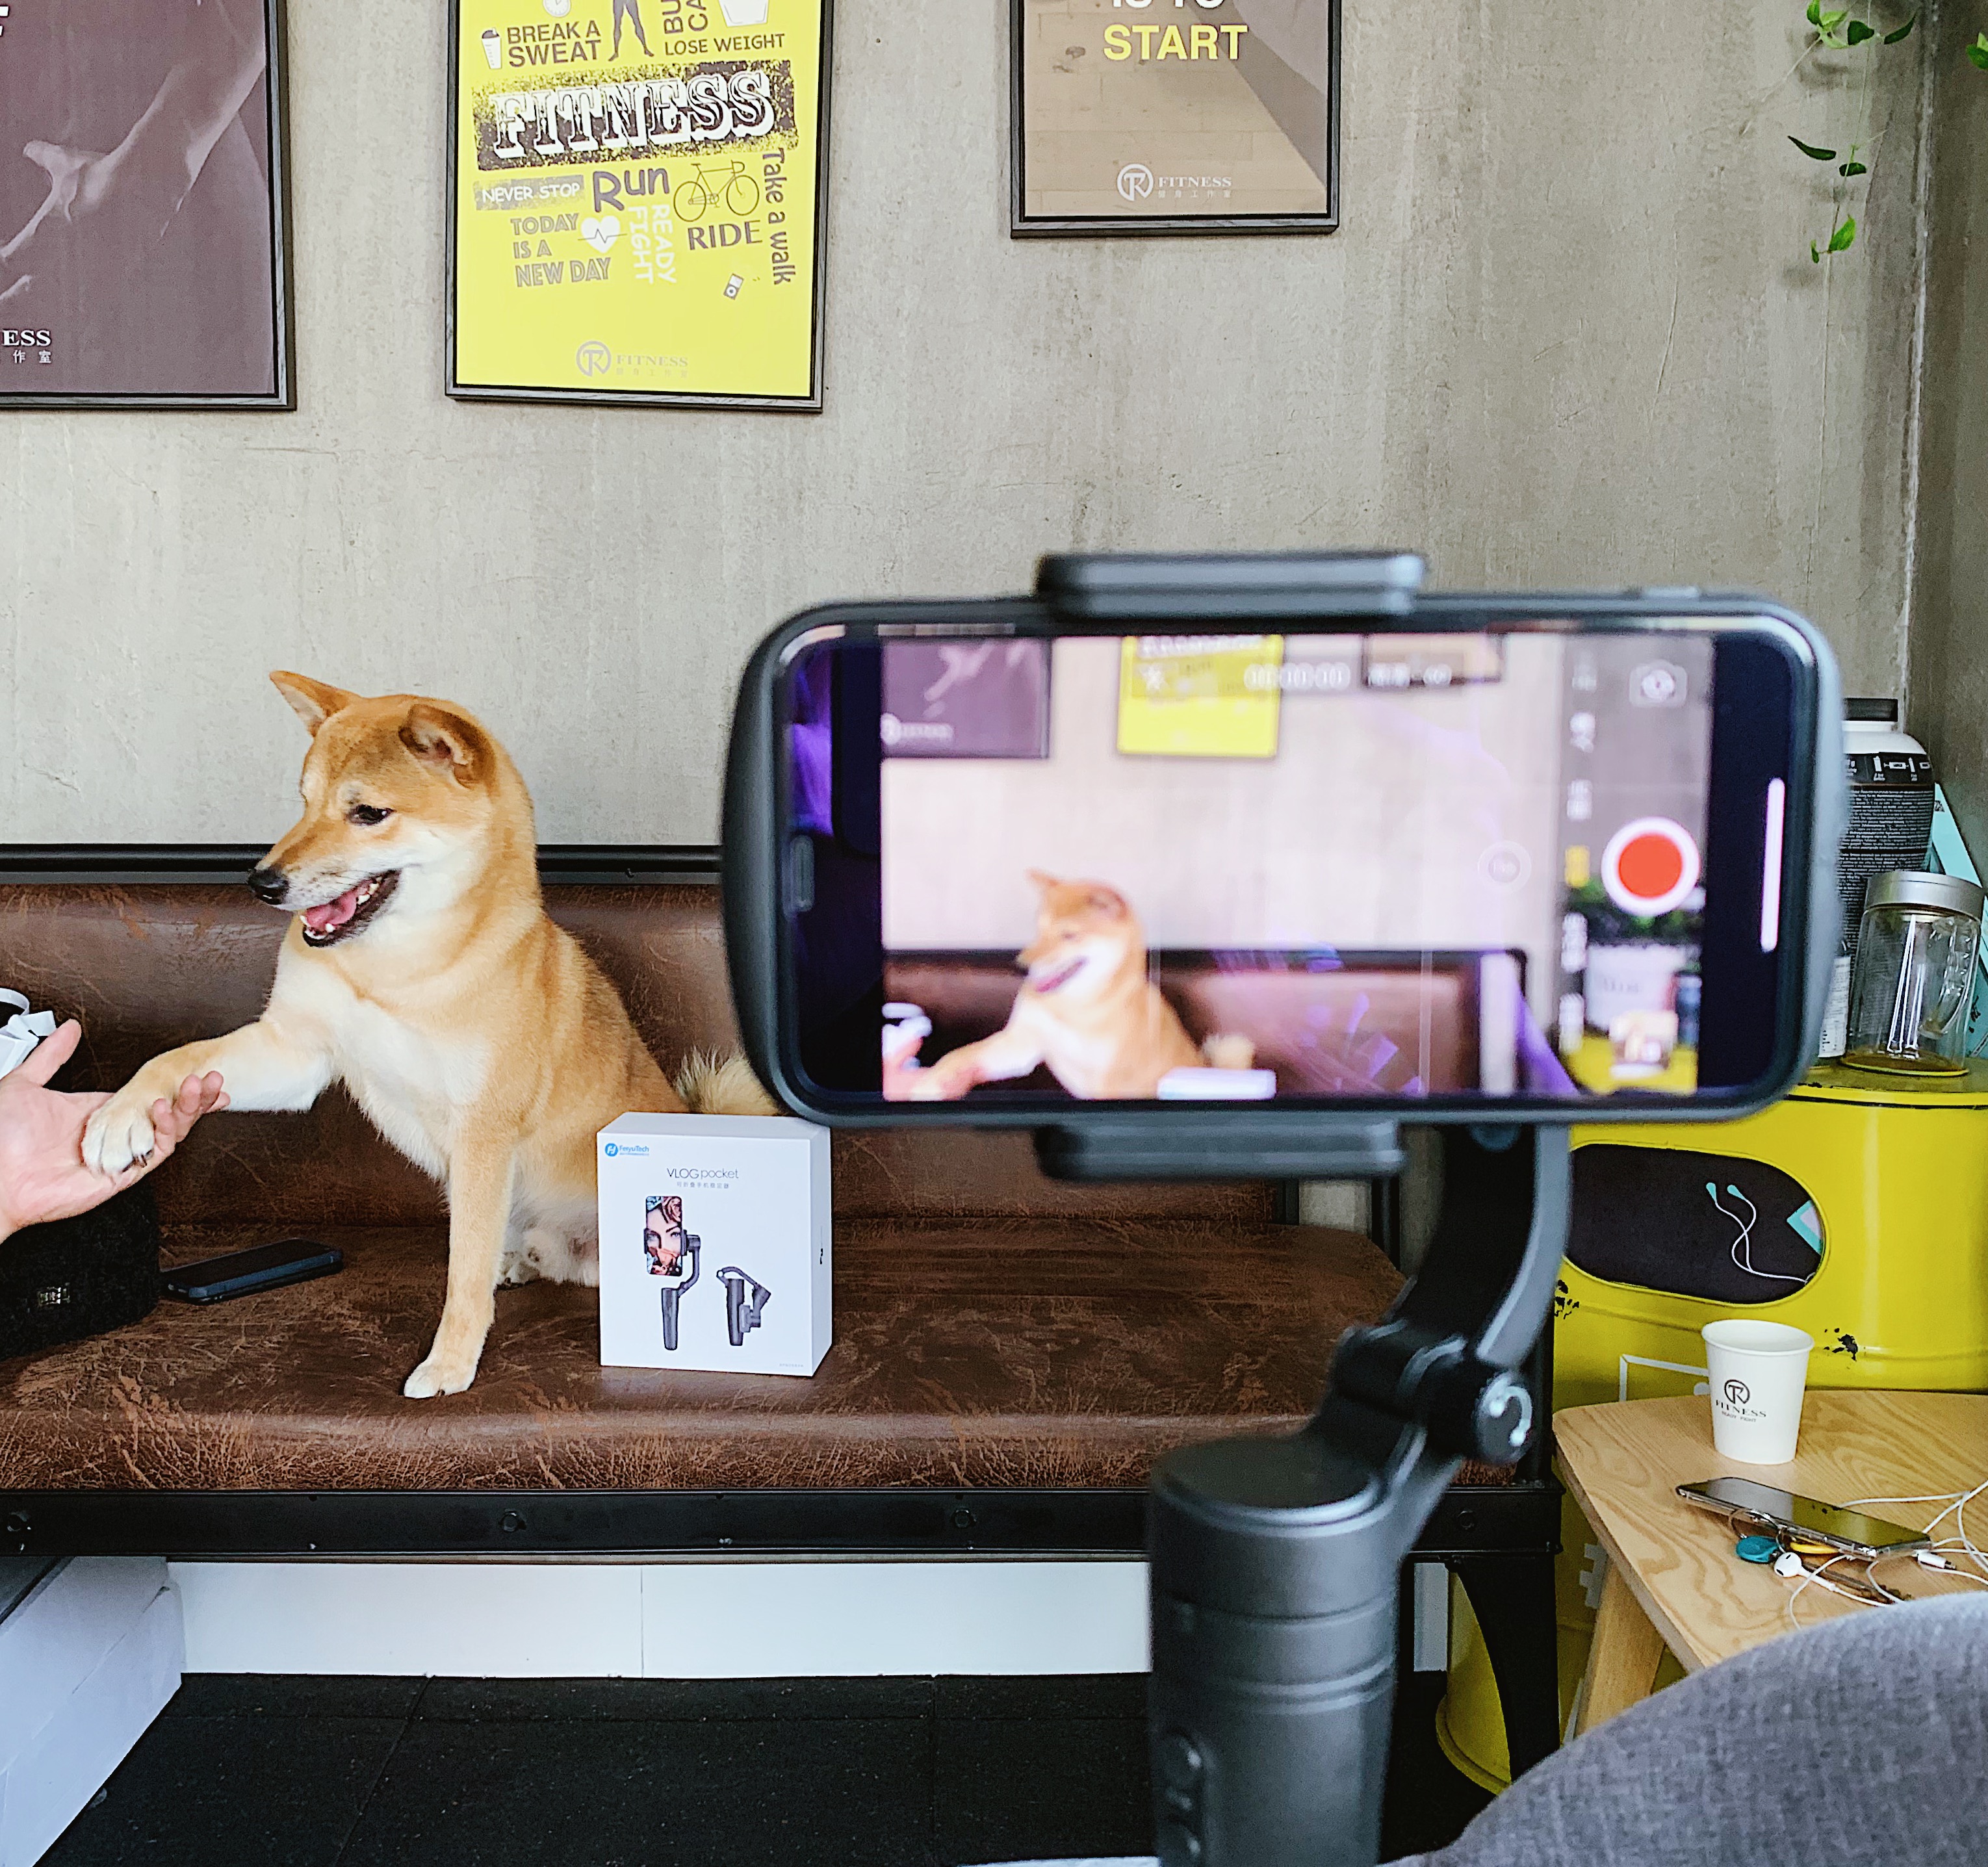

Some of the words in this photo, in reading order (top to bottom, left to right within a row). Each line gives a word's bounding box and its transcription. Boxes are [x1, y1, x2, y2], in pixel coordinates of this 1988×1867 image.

[507, 21, 581, 44] BREAK
[586, 20, 601, 38] A
[665, 38, 708, 56] LOSE
[714, 33, 784, 52] WEIGHT
[1103, 23, 1248, 60] START
[508, 39, 601, 67] SWEAT
[489, 70, 775, 159] FITNESS
[762, 148, 787, 203] Take
[1159, 177, 1232, 188] FITNESS
[482, 186, 533, 203] NEVER
[539, 183, 580, 199] STOP
[593, 168, 669, 212] Run
[510, 212, 579, 235] TODAY
[768, 211, 786, 224] a
[628, 206, 654, 284] FIGHT
[652, 204, 677, 283] READY
[688, 220, 762, 250] RIDE
[513, 240, 531, 259] IS
[537, 239, 552, 257] A
[770, 231, 796, 285] walk
[515, 261, 564, 287] NEW
[570, 257, 611, 283] DAY
[616, 354, 688, 368] FITNESS
[667, 1168, 699, 1179] VLOG
[701, 1168, 739, 1179] pocket
[1716, 1400, 1766, 1417] FITNESS
